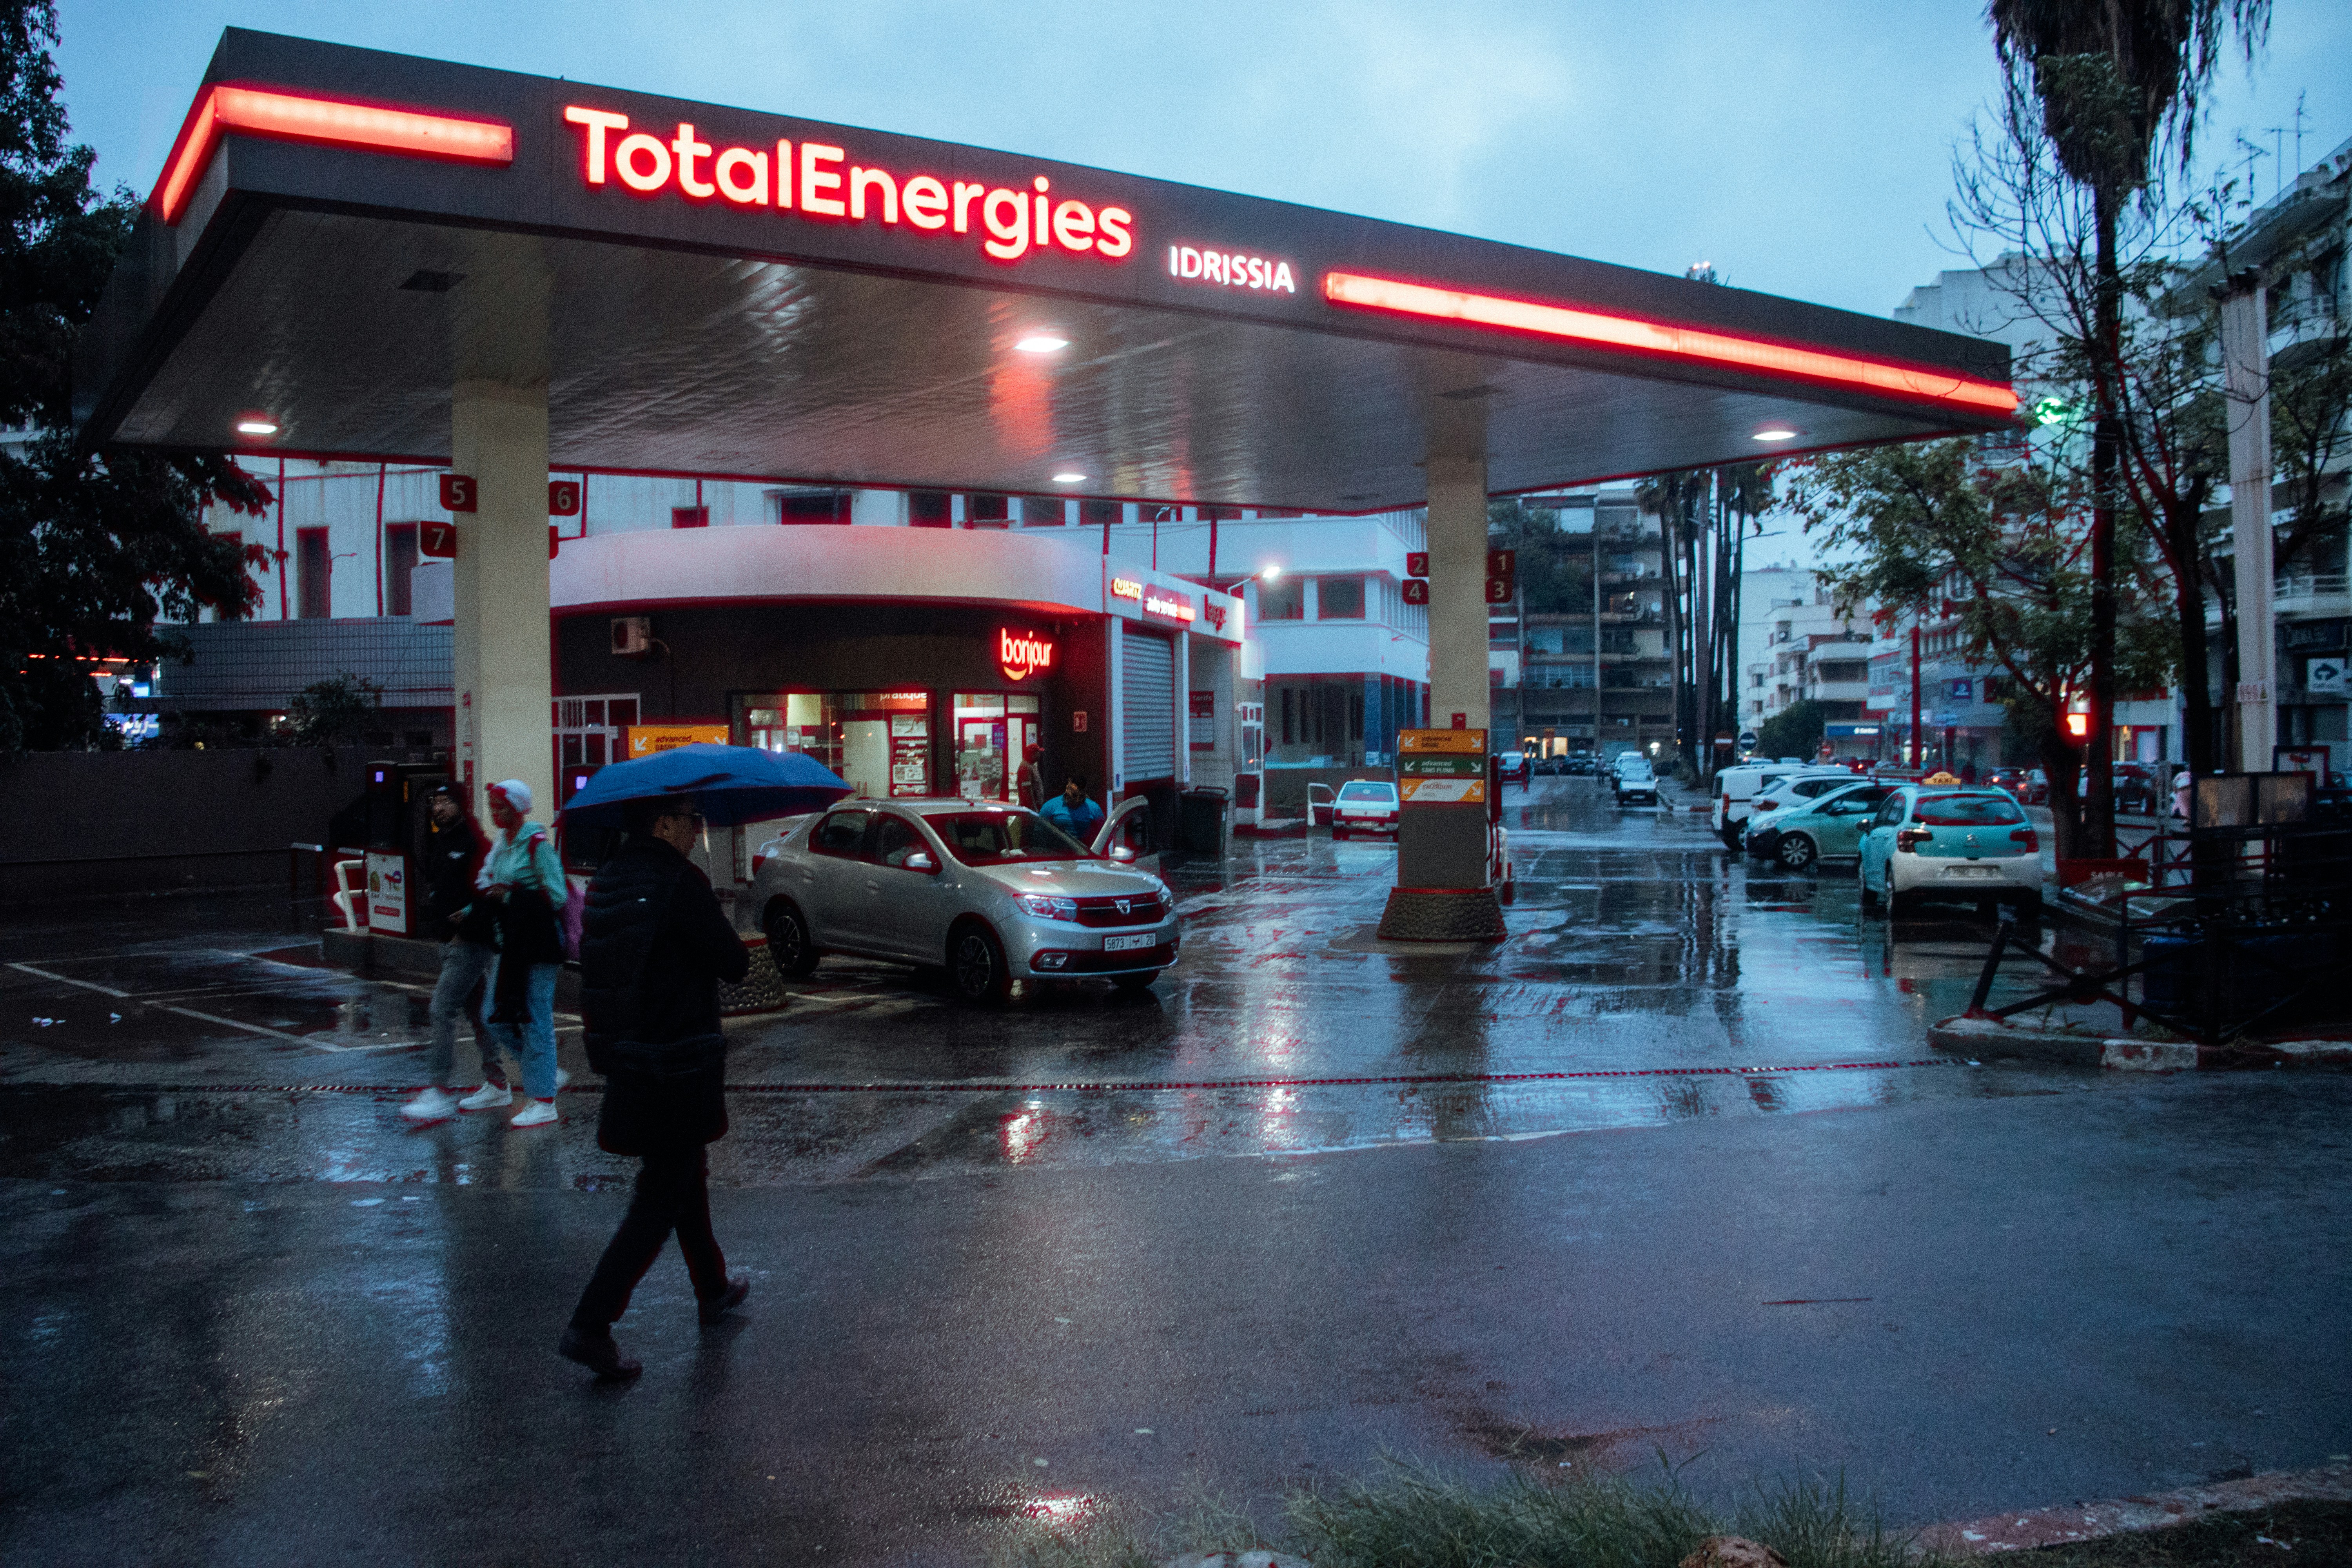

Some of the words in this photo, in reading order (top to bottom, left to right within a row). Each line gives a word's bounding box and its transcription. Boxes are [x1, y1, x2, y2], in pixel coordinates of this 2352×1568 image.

[564, 105, 1132, 259] TotalEnergies
[1169, 245, 1295, 294] IDRISSIA
[452, 481, 466, 505] 5
[557, 487, 572, 510] 6
[432, 528, 445, 550] 7
[1413, 557, 1425, 574] 2
[1498, 555, 1506, 571] 1
[1113, 577, 1142, 600] QUARTZ
[1408, 582, 1422, 600] 4
[1494, 581, 1505, 599] 3
[1001, 627, 1053, 675] bonjour
[655, 735, 692, 743] advanced
